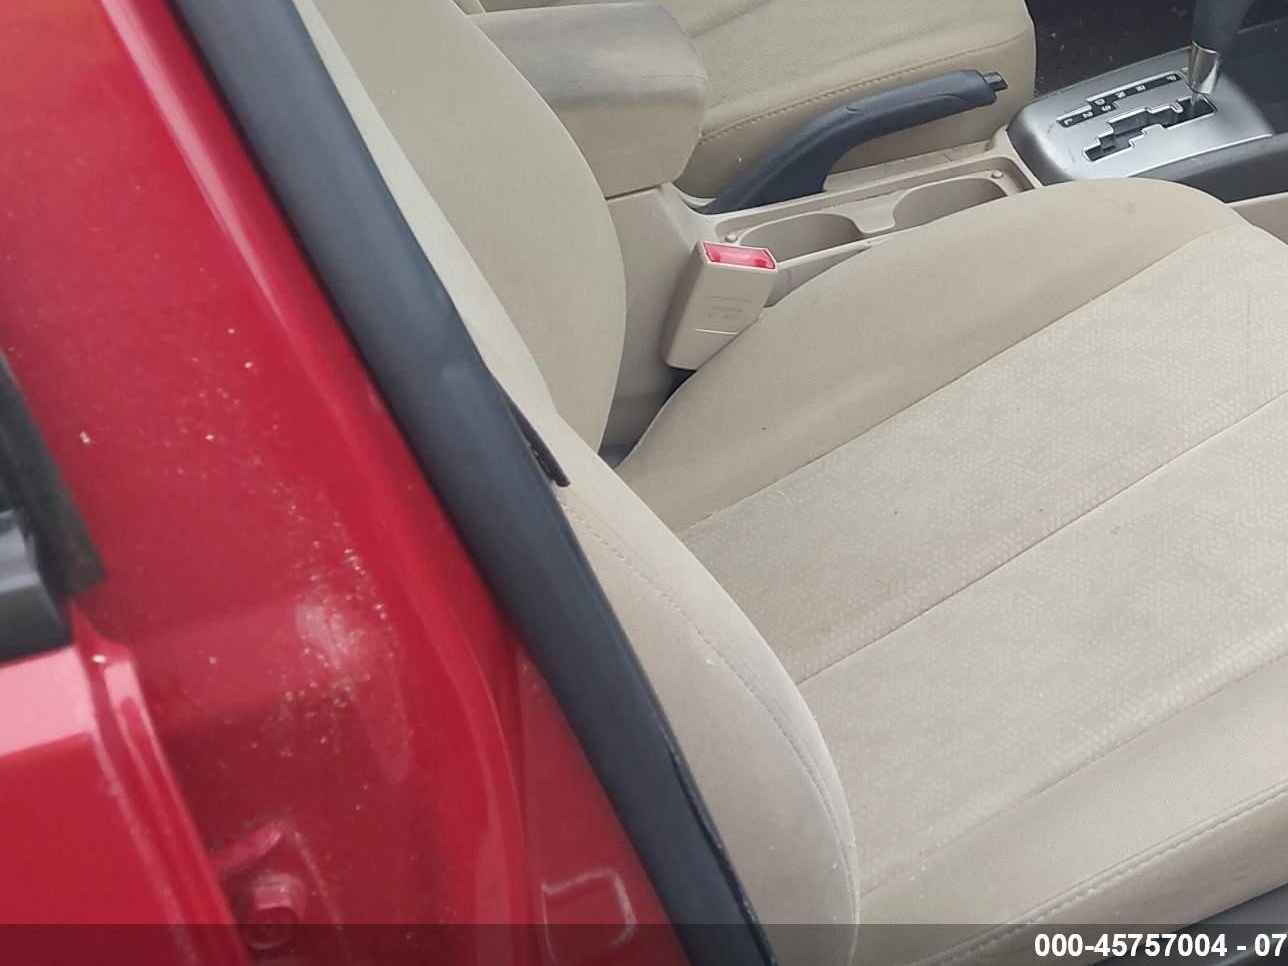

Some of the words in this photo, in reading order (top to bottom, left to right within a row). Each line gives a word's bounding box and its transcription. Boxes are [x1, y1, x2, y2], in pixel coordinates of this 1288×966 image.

[1135, 84, 1146, 92] R
[1094, 98, 1106, 106] D
[1082, 111, 1094, 119] 2
[1063, 118, 1074, 126] L
